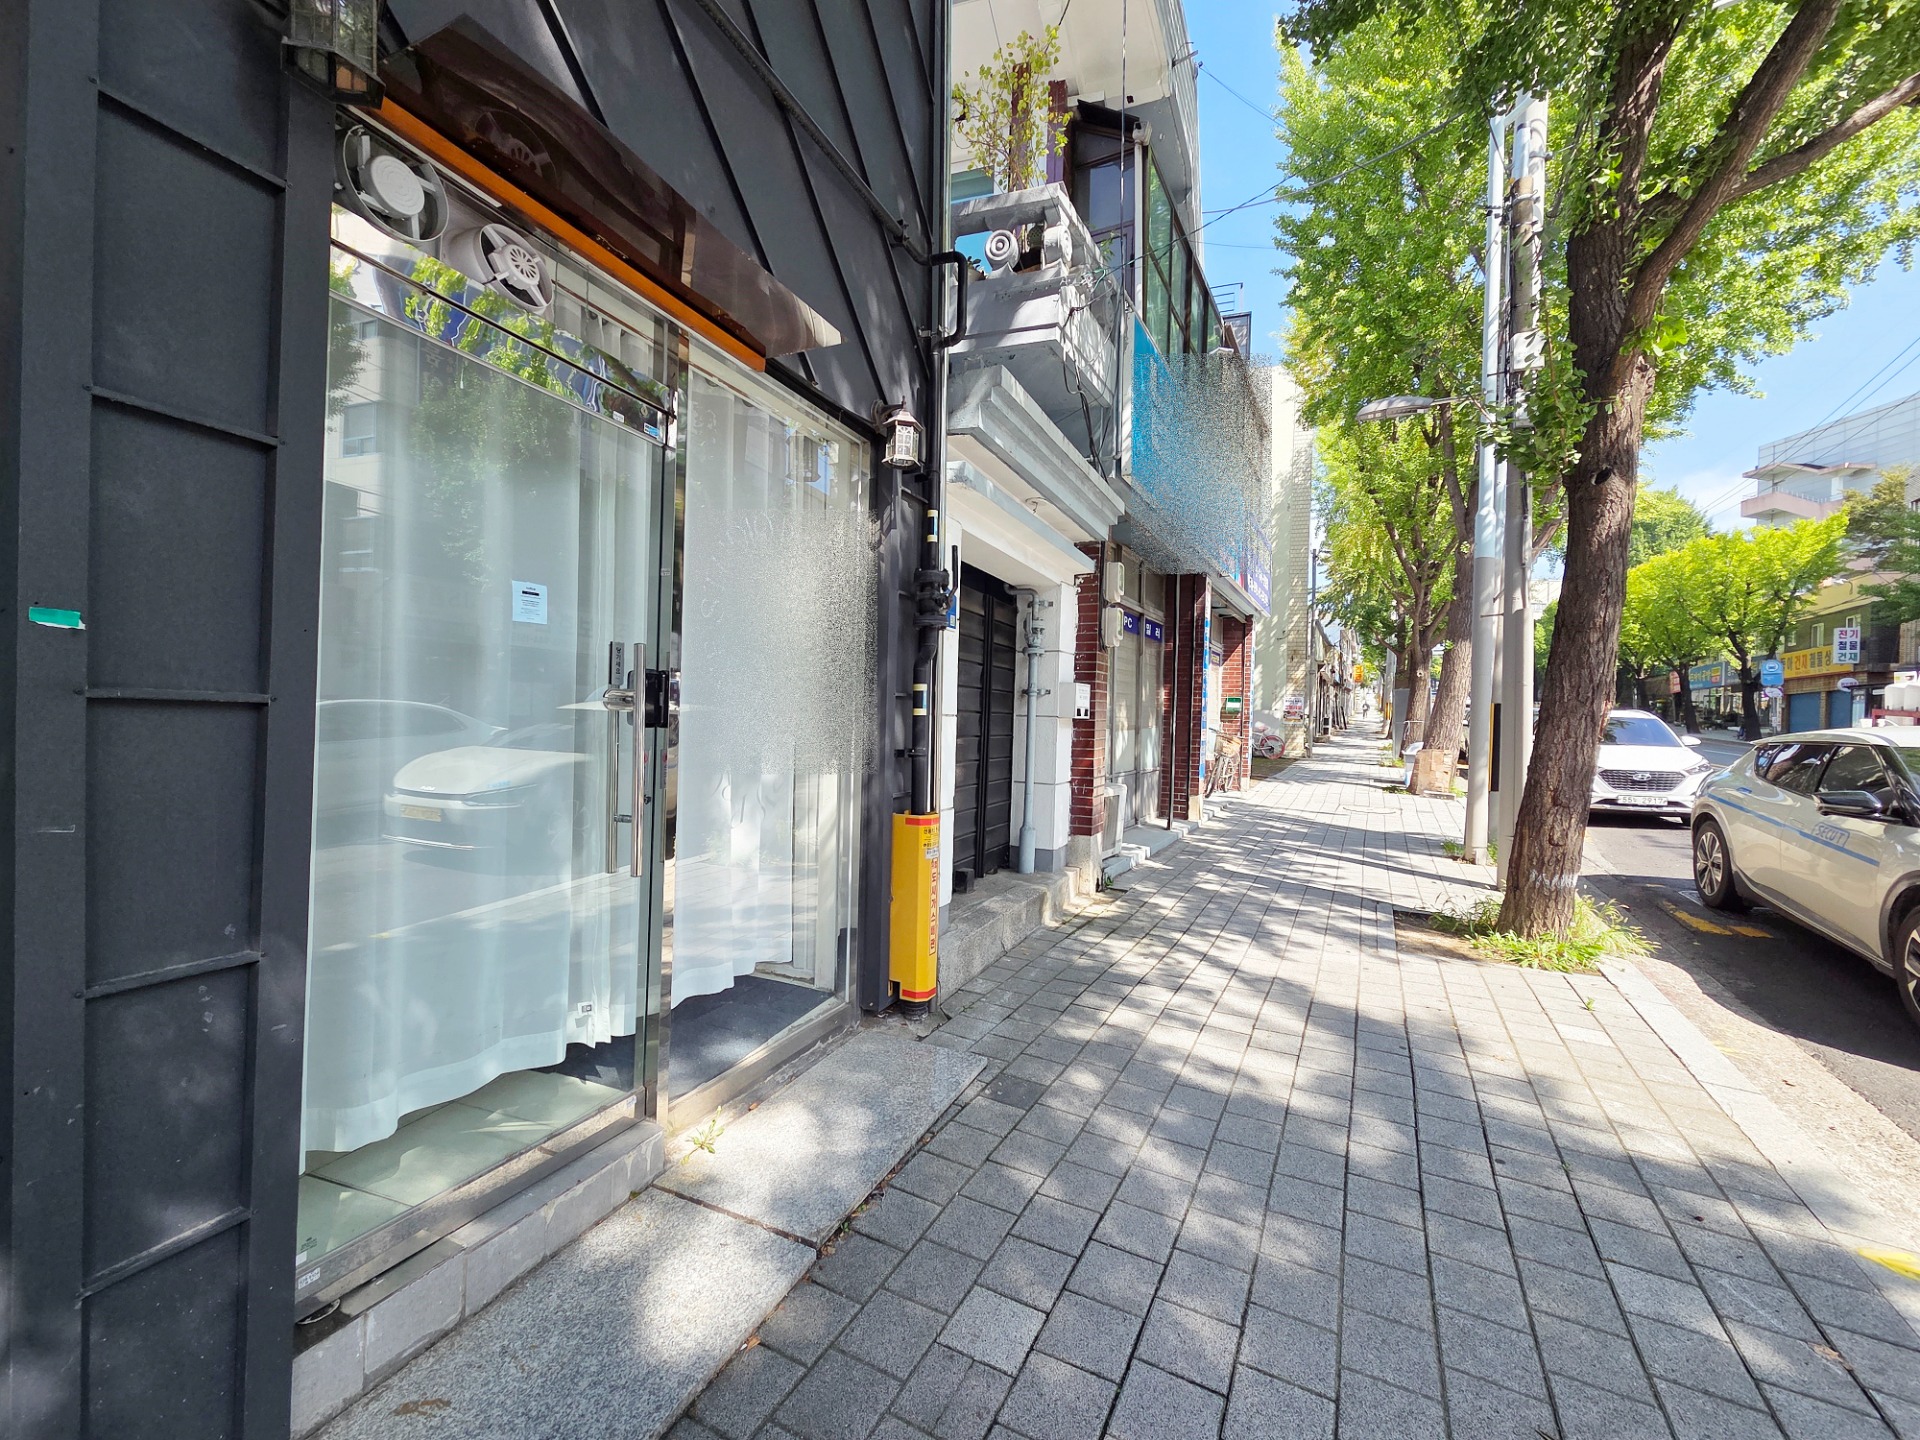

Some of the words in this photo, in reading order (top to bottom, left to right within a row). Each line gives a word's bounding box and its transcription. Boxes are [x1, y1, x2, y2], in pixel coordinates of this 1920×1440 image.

[1123, 615, 1133, 629] PC
[1838, 629, 1858, 640] 전기
[1838, 640, 1858, 651] 철물
[1794, 654, 1808, 671] 건재
[1838, 652, 1858, 662] 건재
